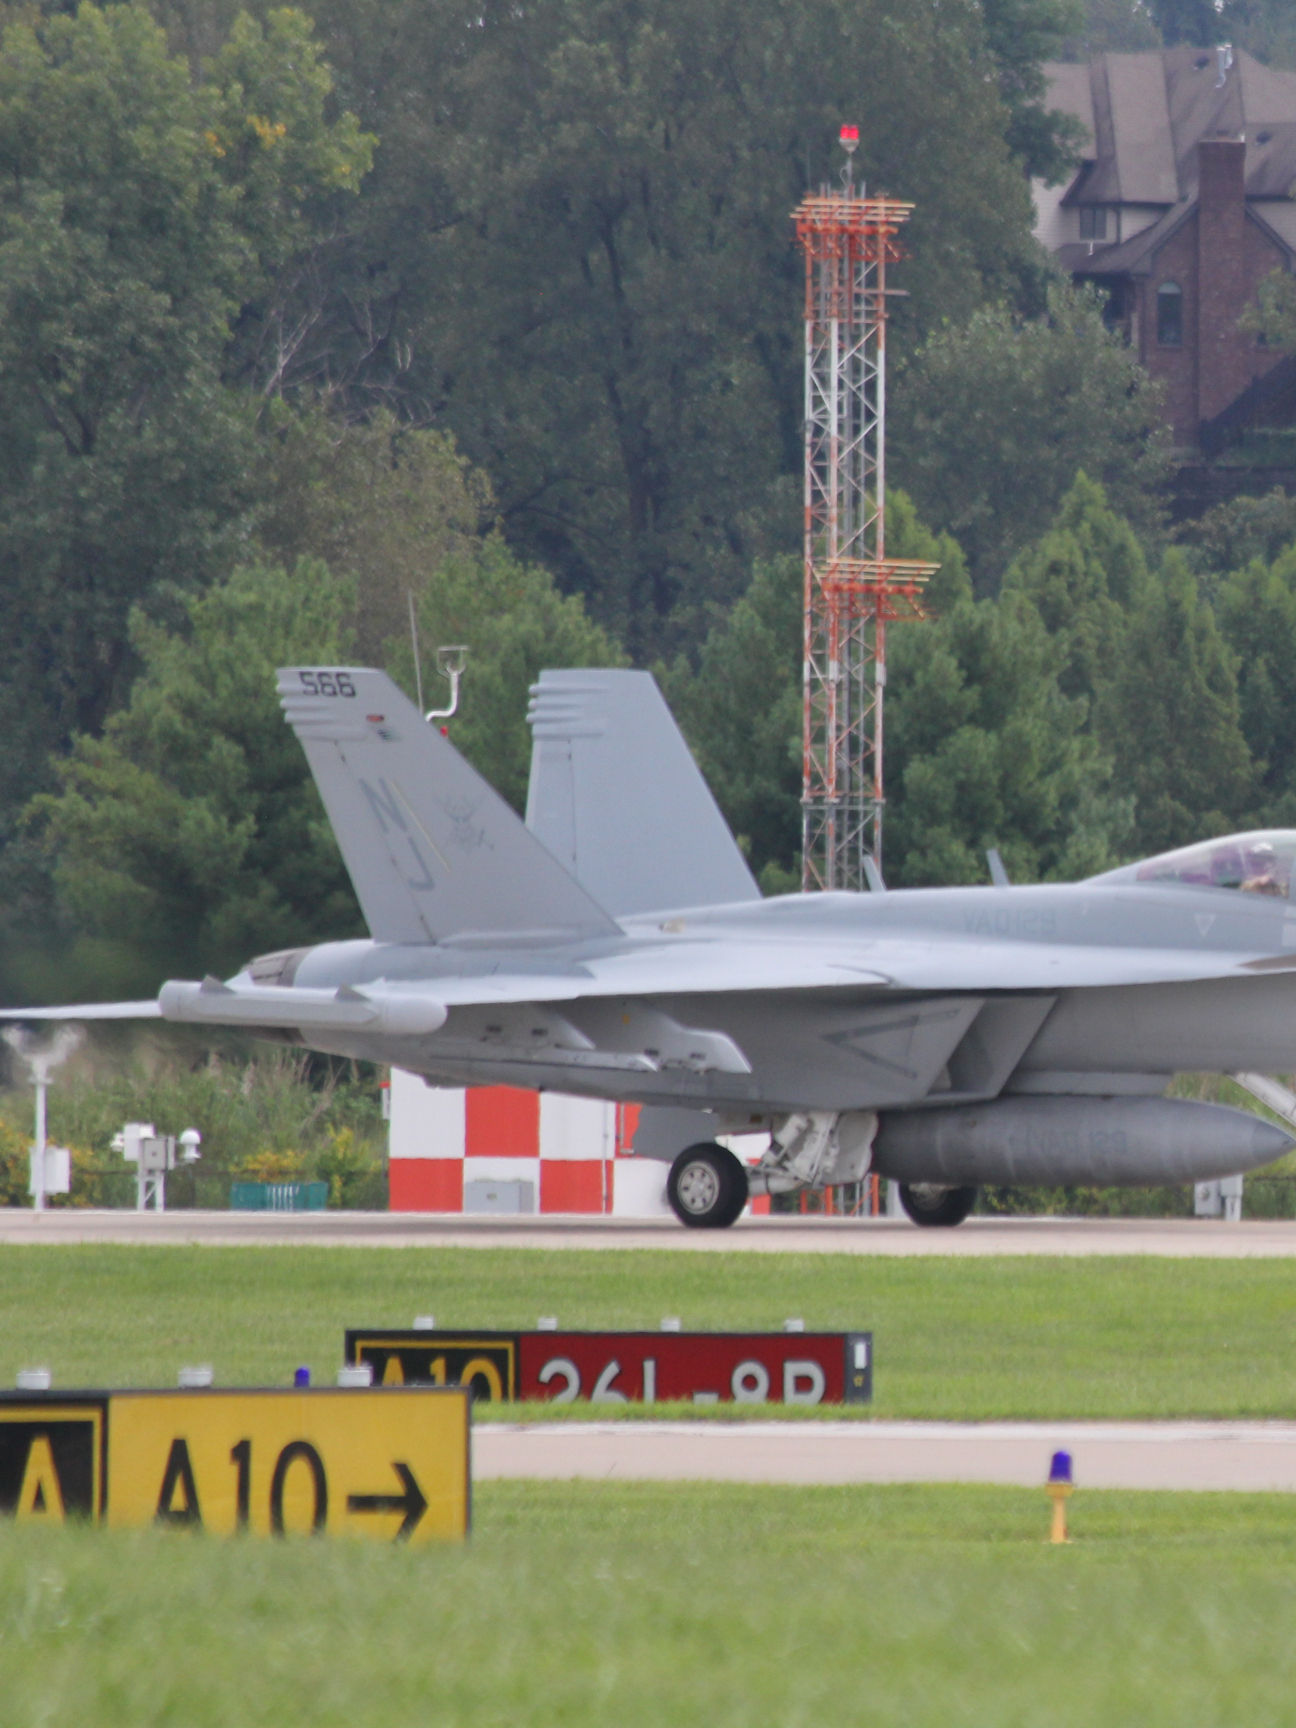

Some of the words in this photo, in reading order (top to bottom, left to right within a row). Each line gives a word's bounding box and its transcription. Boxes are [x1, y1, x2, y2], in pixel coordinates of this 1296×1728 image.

[299, 671, 356, 697] 566
[14, 1434, 66, 1525] A
[154, 1438, 329, 1539] A10
